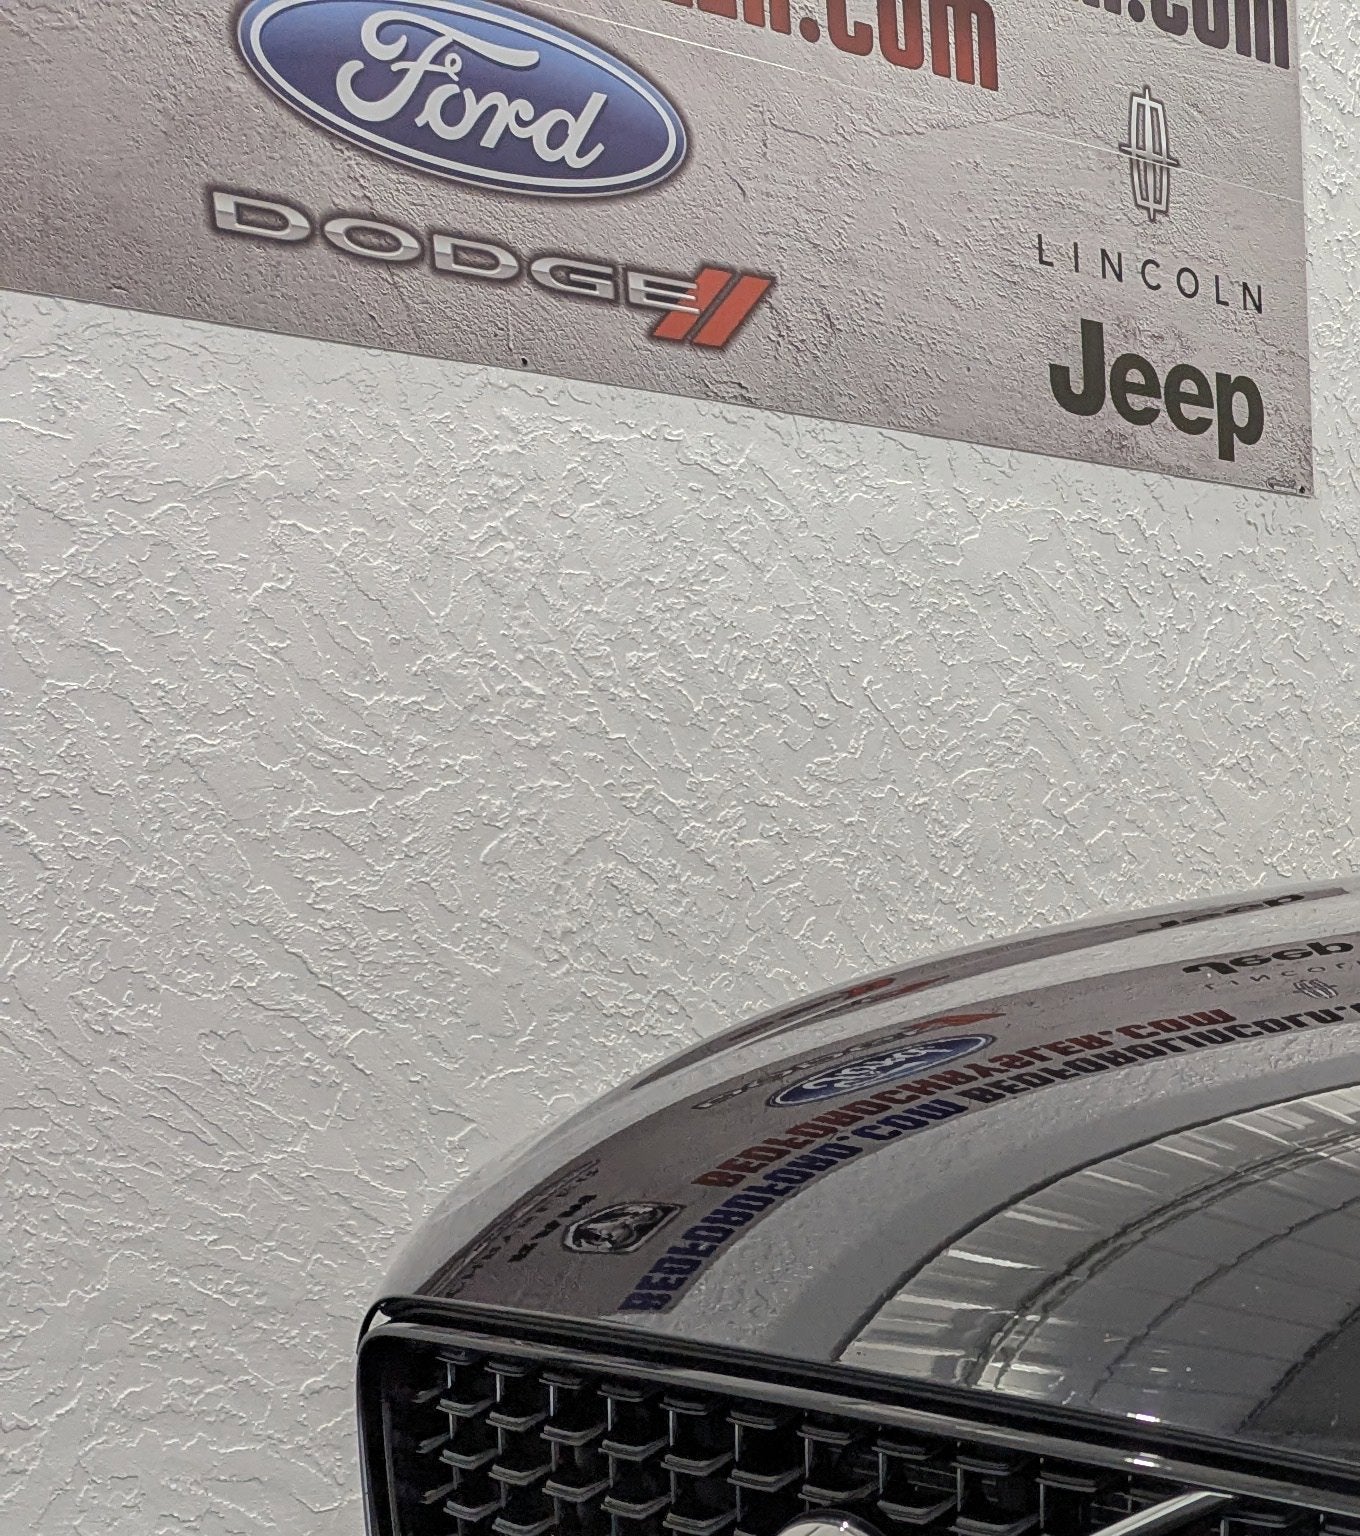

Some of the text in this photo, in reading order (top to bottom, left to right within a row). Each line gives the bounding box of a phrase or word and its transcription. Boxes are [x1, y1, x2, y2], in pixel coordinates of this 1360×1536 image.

[336, 9, 607, 169] Ford
[213, 191, 699, 313] DODGE
[1037, 233, 1263, 314] LINCOLN
[1049, 317, 1265, 462] Jeep
